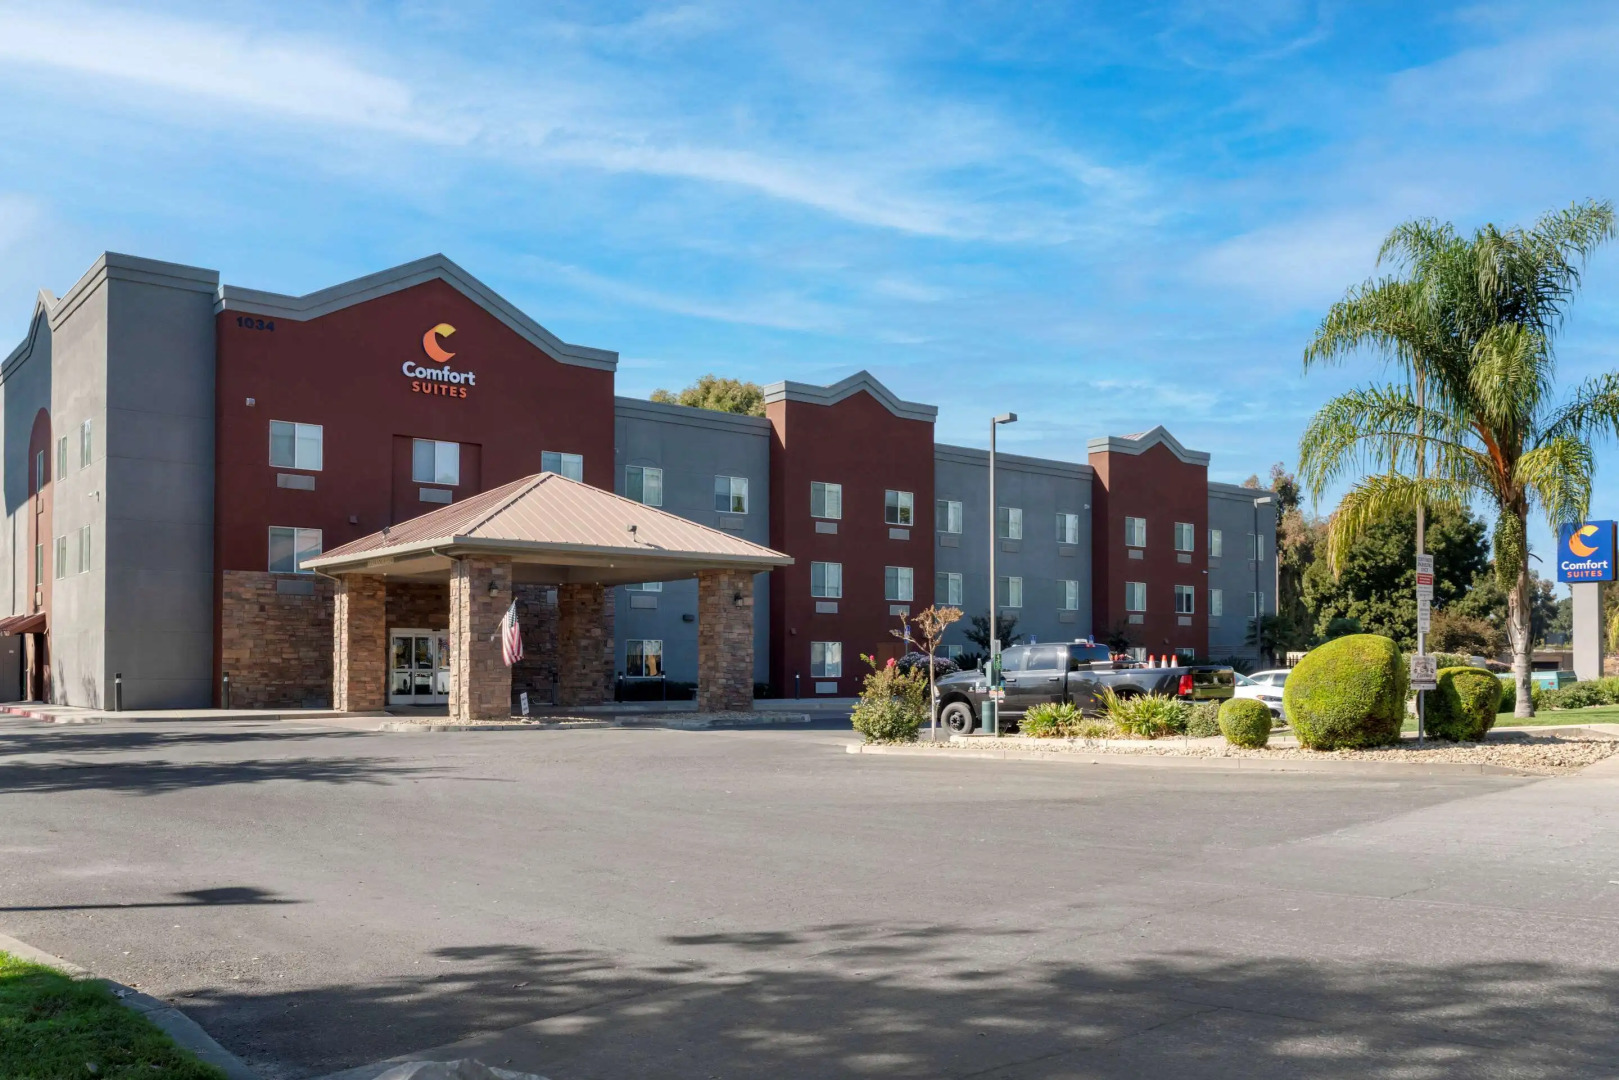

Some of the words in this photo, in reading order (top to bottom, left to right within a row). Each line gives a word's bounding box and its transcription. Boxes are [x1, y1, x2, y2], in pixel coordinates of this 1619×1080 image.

[236, 316, 275, 332] 1034
[402, 361, 476, 386] Comfort
[411, 381, 467, 399] SUITES
[1561, 560, 1608, 570] Comfort
[1567, 570, 1603, 578] SUITES
